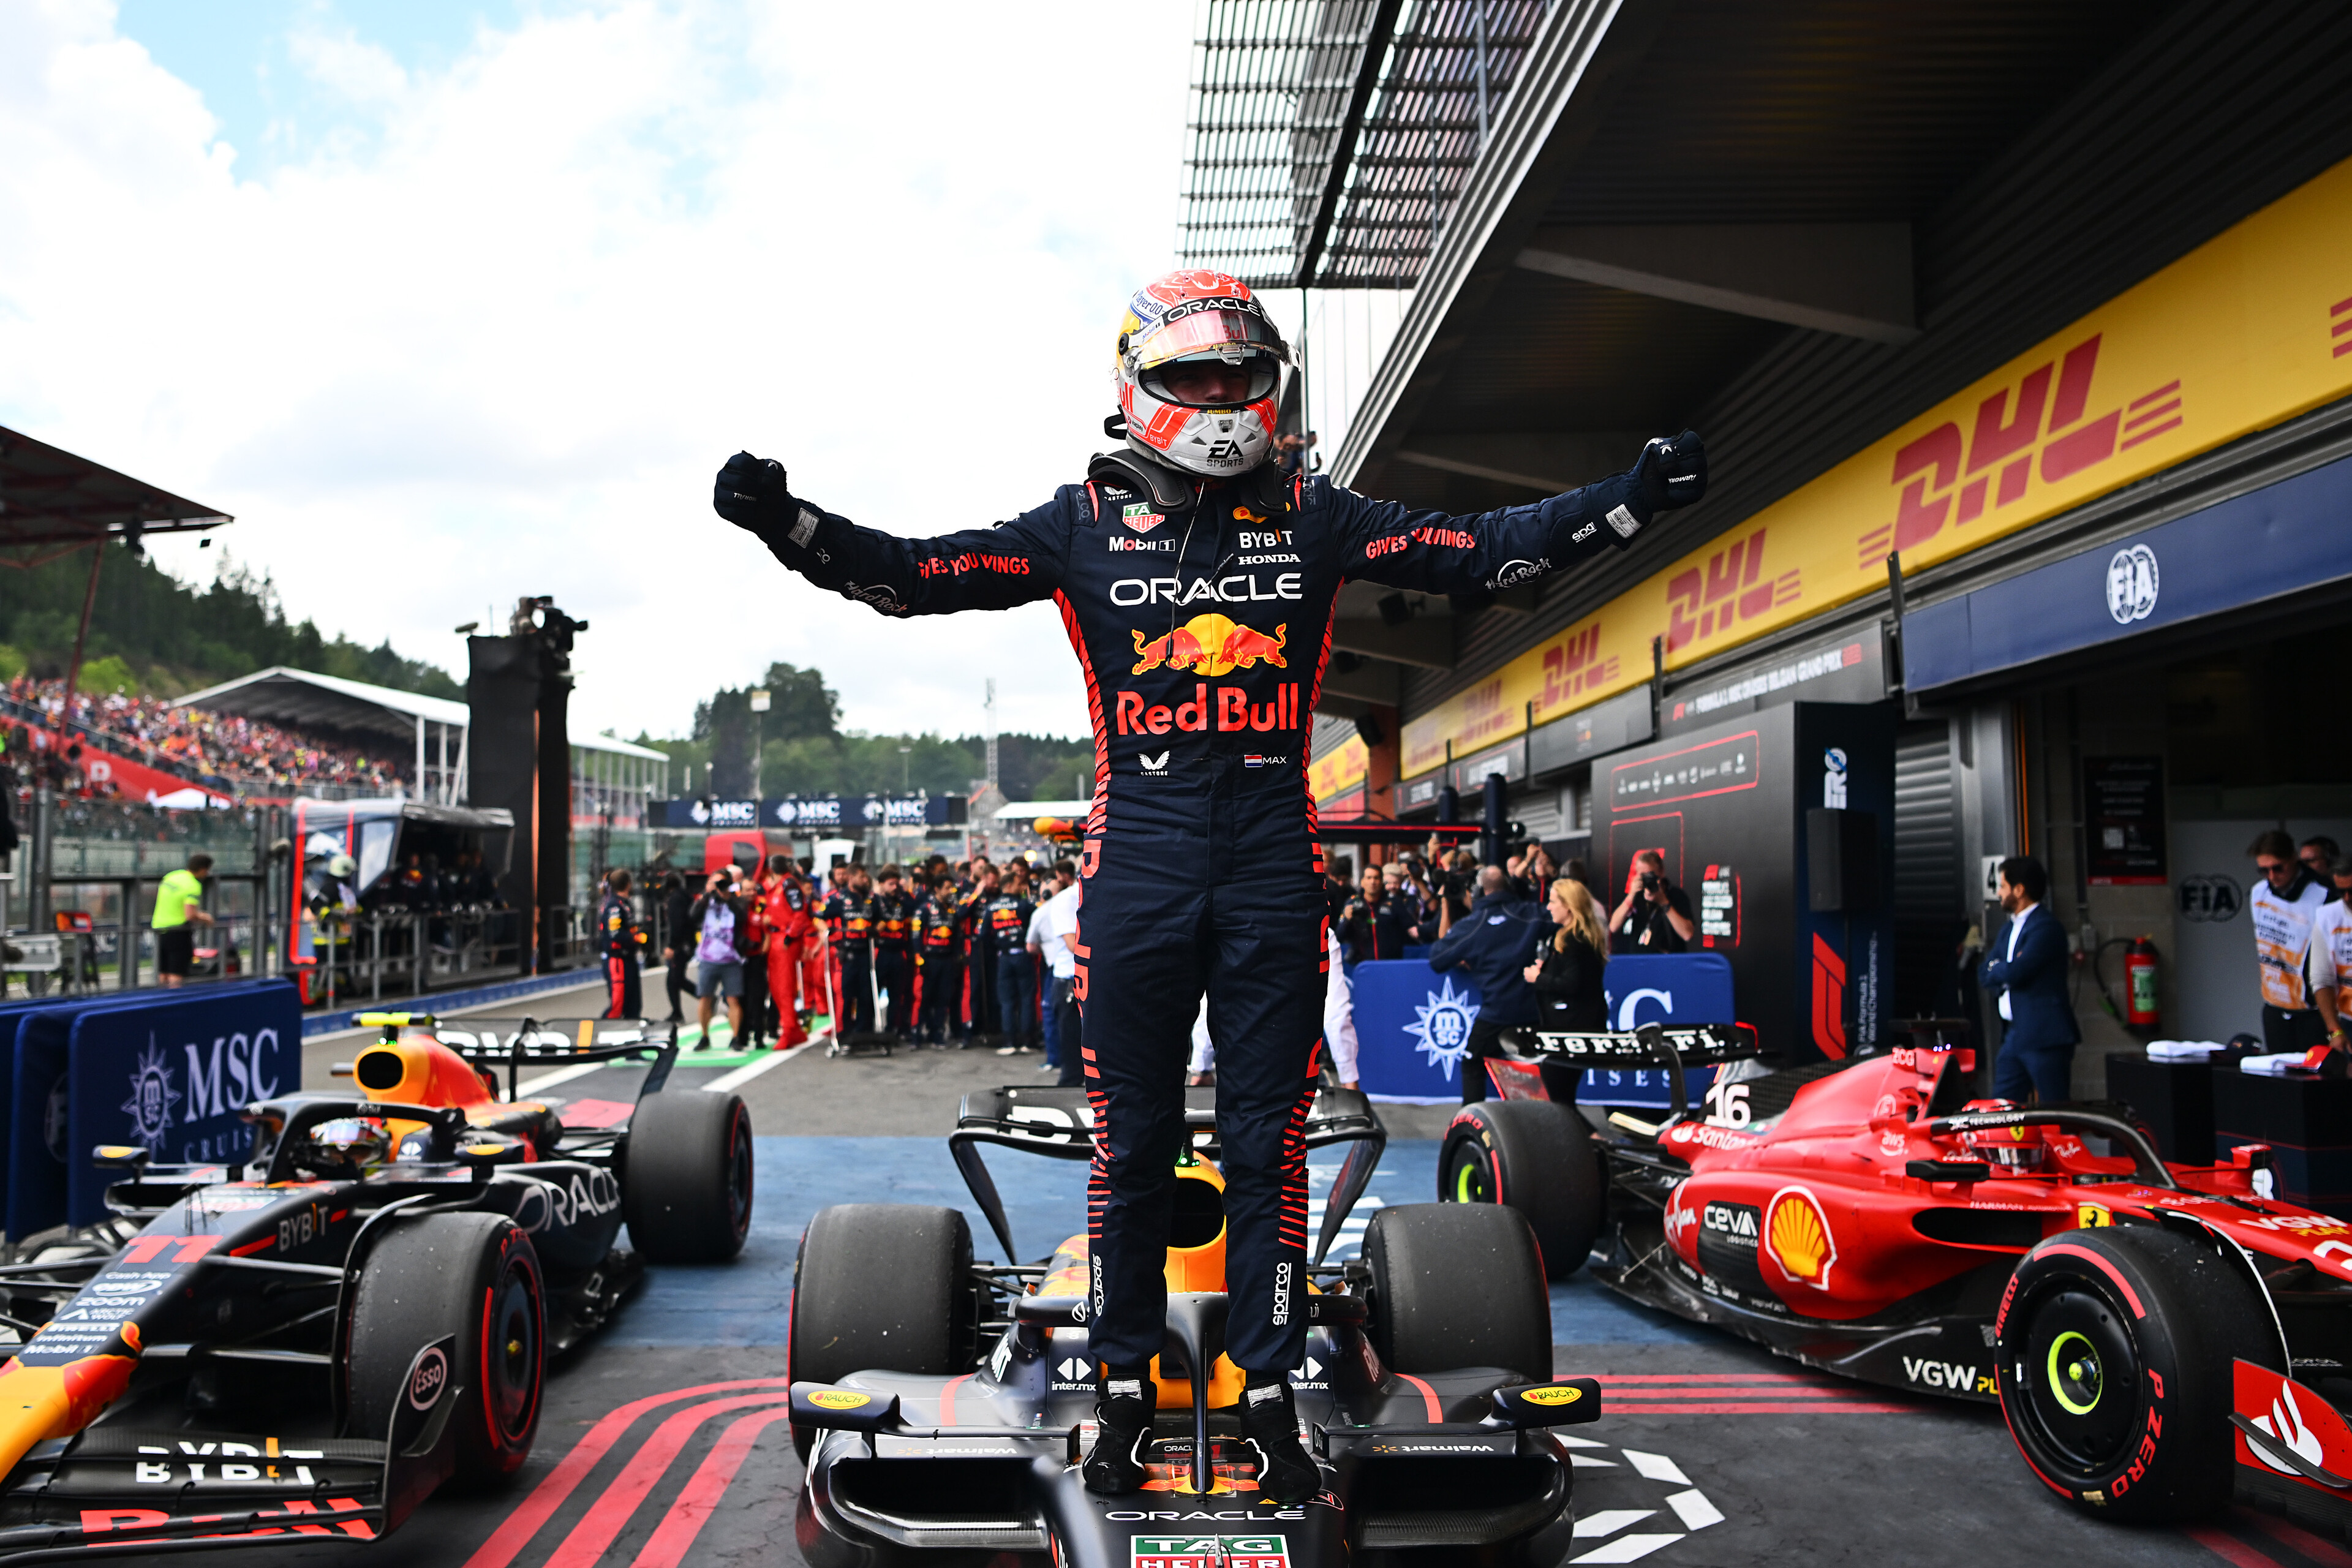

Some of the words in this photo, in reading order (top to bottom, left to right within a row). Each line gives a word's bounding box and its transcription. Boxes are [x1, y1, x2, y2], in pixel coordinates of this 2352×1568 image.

[1167, 299, 1261, 322] ORACLE
[1149, 434, 1167, 447] BYBIT
[1208, 439, 1243, 458] EA
[1891, 333, 2123, 553] DHL
[1207, 457, 1243, 468] SPORTS
[1127, 505, 1150, 516] TA
[1125, 516, 1163, 530] HEUER
[1109, 537, 1156, 551] Mobil
[1238, 529, 1293, 549] BYBIT
[1365, 535, 1408, 559] GIVES
[949, 552, 979, 576] YOU
[1238, 554, 1301, 565] HONDA
[1485, 571, 1518, 590] Hard
[1517, 557, 1552, 579] Rock
[844, 580, 882, 601] Hard
[1109, 573, 1303, 606] ORACLE
[1666, 528, 1776, 653] DHL
[1544, 624, 1605, 709] DHL
[1116, 683, 1207, 735] Red
[1217, 682, 1299, 733] Bull
[1262, 756, 1287, 765] MAX
[711, 802, 755, 820] MSC
[797, 801, 841, 819] MSC
[886, 800, 925, 818] MSC
[1987, 862, 1997, 891] 4
[185, 1027, 279, 1123] MSC
[1705, 1084, 1751, 1130] 16
[1969, 1113, 2025, 1126] TECHNOLOGY
[1882, 1131, 1905, 1148] aws
[1970, 1200, 2024, 1211] HARMAN
[279, 1202, 329, 1253] BYBIT
[123, 1235, 224, 1263] 11
[105, 1271, 141, 1280] Cash
[140, 1271, 172, 1280] App
[1092, 1253, 1104, 1317] sparco
[1272, 1262, 1292, 1325] sparco
[48, 1322, 121, 1332] PIRELLI
[24, 1344, 80, 1354] Mobil
[1902, 1355, 1977, 1390] VGW
[1977, 1376, 1999, 1395] PL
[2148, 1368, 2164, 1399] P
[1051, 1381, 1096, 1392] inter.mx
[1537, 1386, 1574, 1401] RAUCH
[824, 1393, 863, 1403] RAUCH
[926, 1446, 1018, 1455] Walmart
[1211, 1444, 1221, 1460] 1
[1401, 1444, 1495, 1453] Walmart
[2111, 1406, 2163, 1498] ZERO
[135, 1437, 324, 1485] BYBIT
[1105, 1510, 1306, 1521] ORACLE
[1144, 1539, 1273, 1552] TAG
